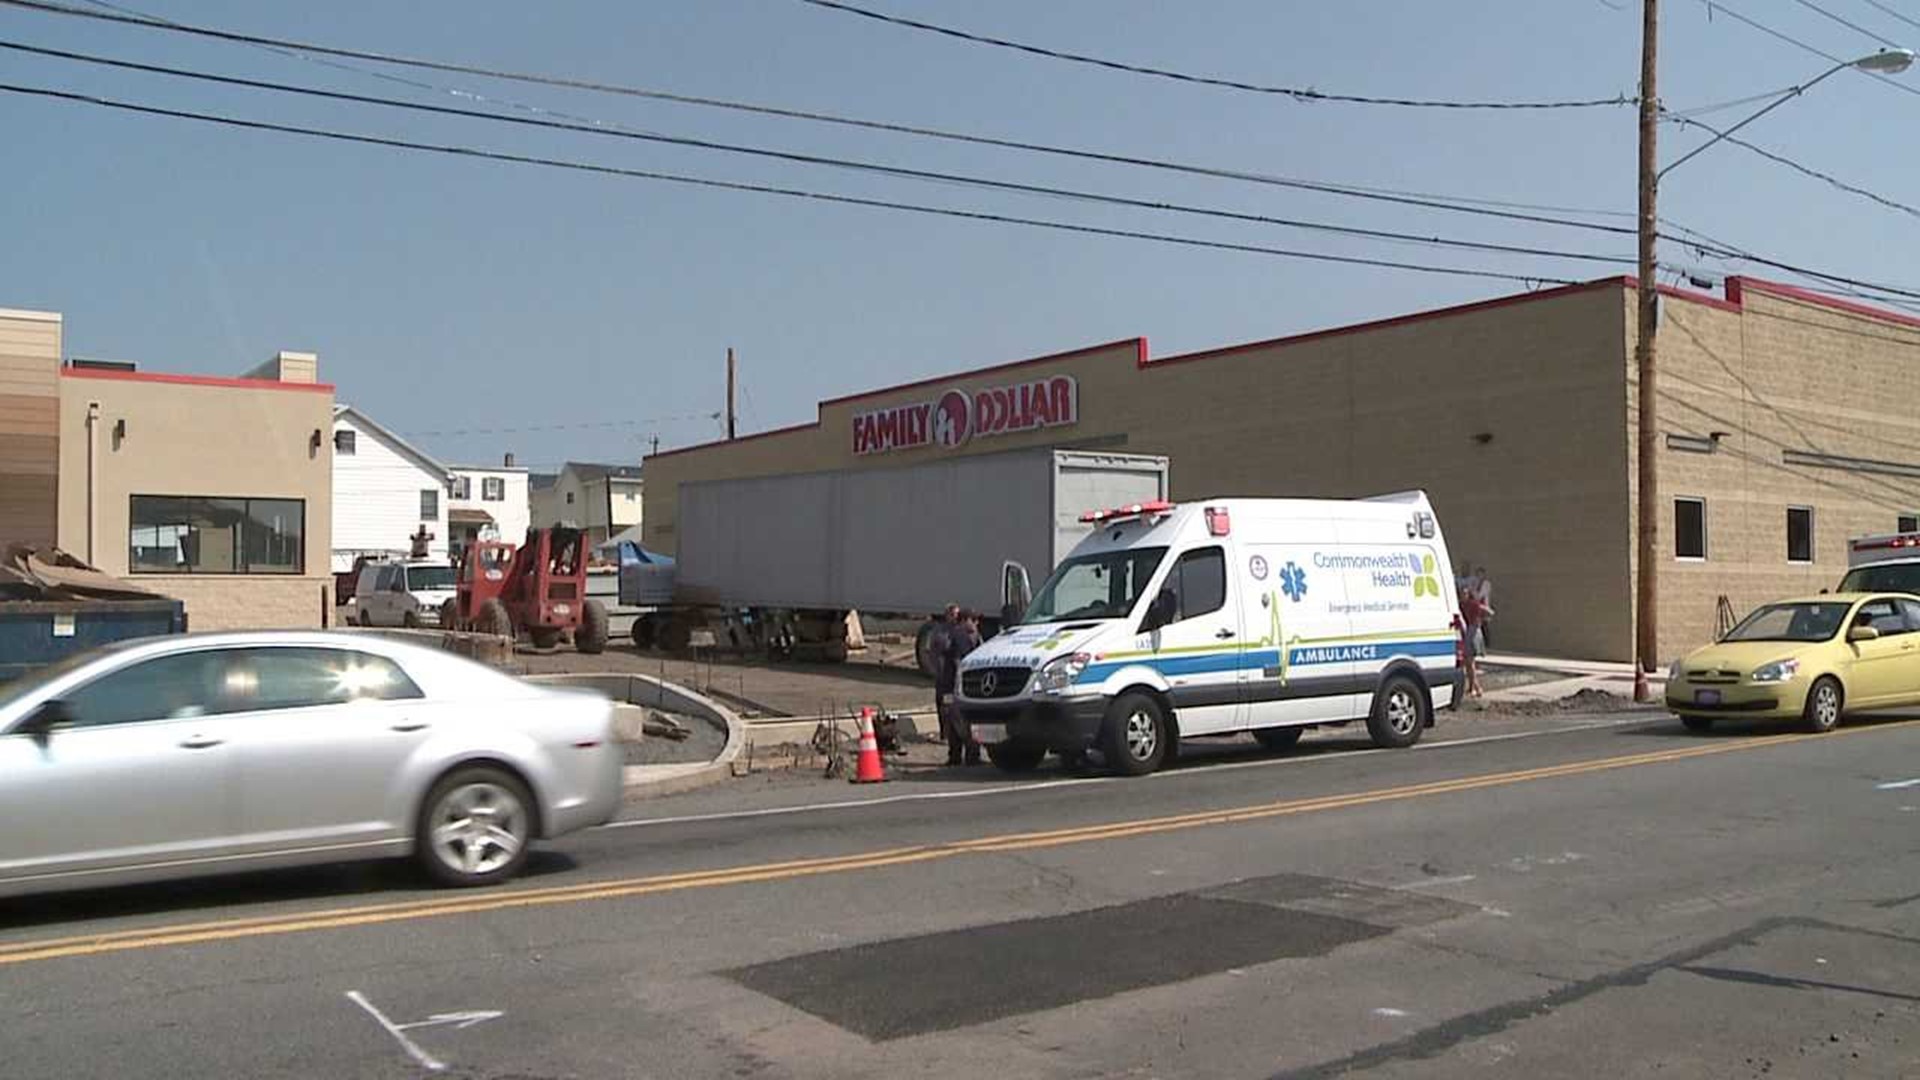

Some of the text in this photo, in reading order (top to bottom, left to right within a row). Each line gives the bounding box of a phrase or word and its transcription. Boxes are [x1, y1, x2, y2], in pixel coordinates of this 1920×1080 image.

[852, 376, 1076, 454] FAMILY DOLLAR
[1313, 552, 1408, 568] Commonwealth
[1373, 570, 1411, 587] Health
[1296, 646, 1376, 663] AMBULANCE
